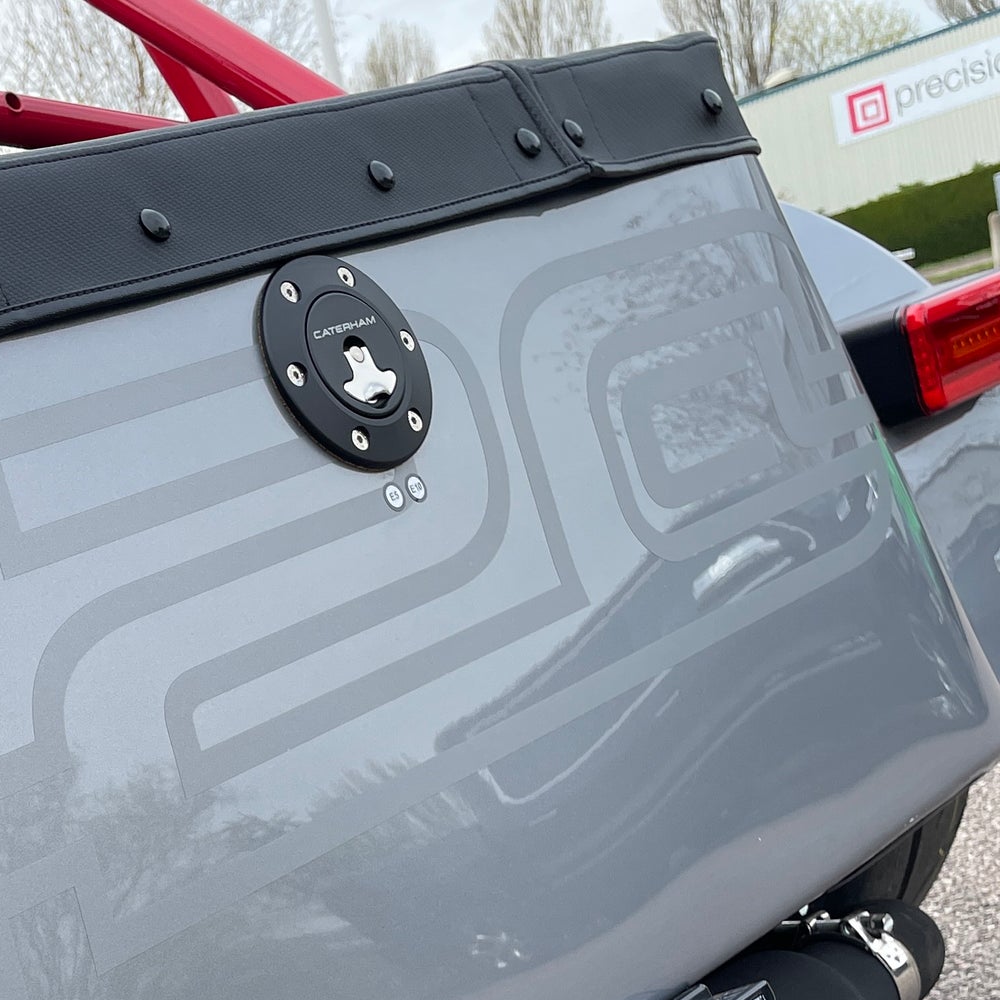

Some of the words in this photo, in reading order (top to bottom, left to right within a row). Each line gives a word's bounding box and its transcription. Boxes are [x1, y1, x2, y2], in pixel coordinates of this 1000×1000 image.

[313, 315, 376, 340] CATERHAM
[409, 482, 423, 494] E10
[389, 490, 400, 501] E5
